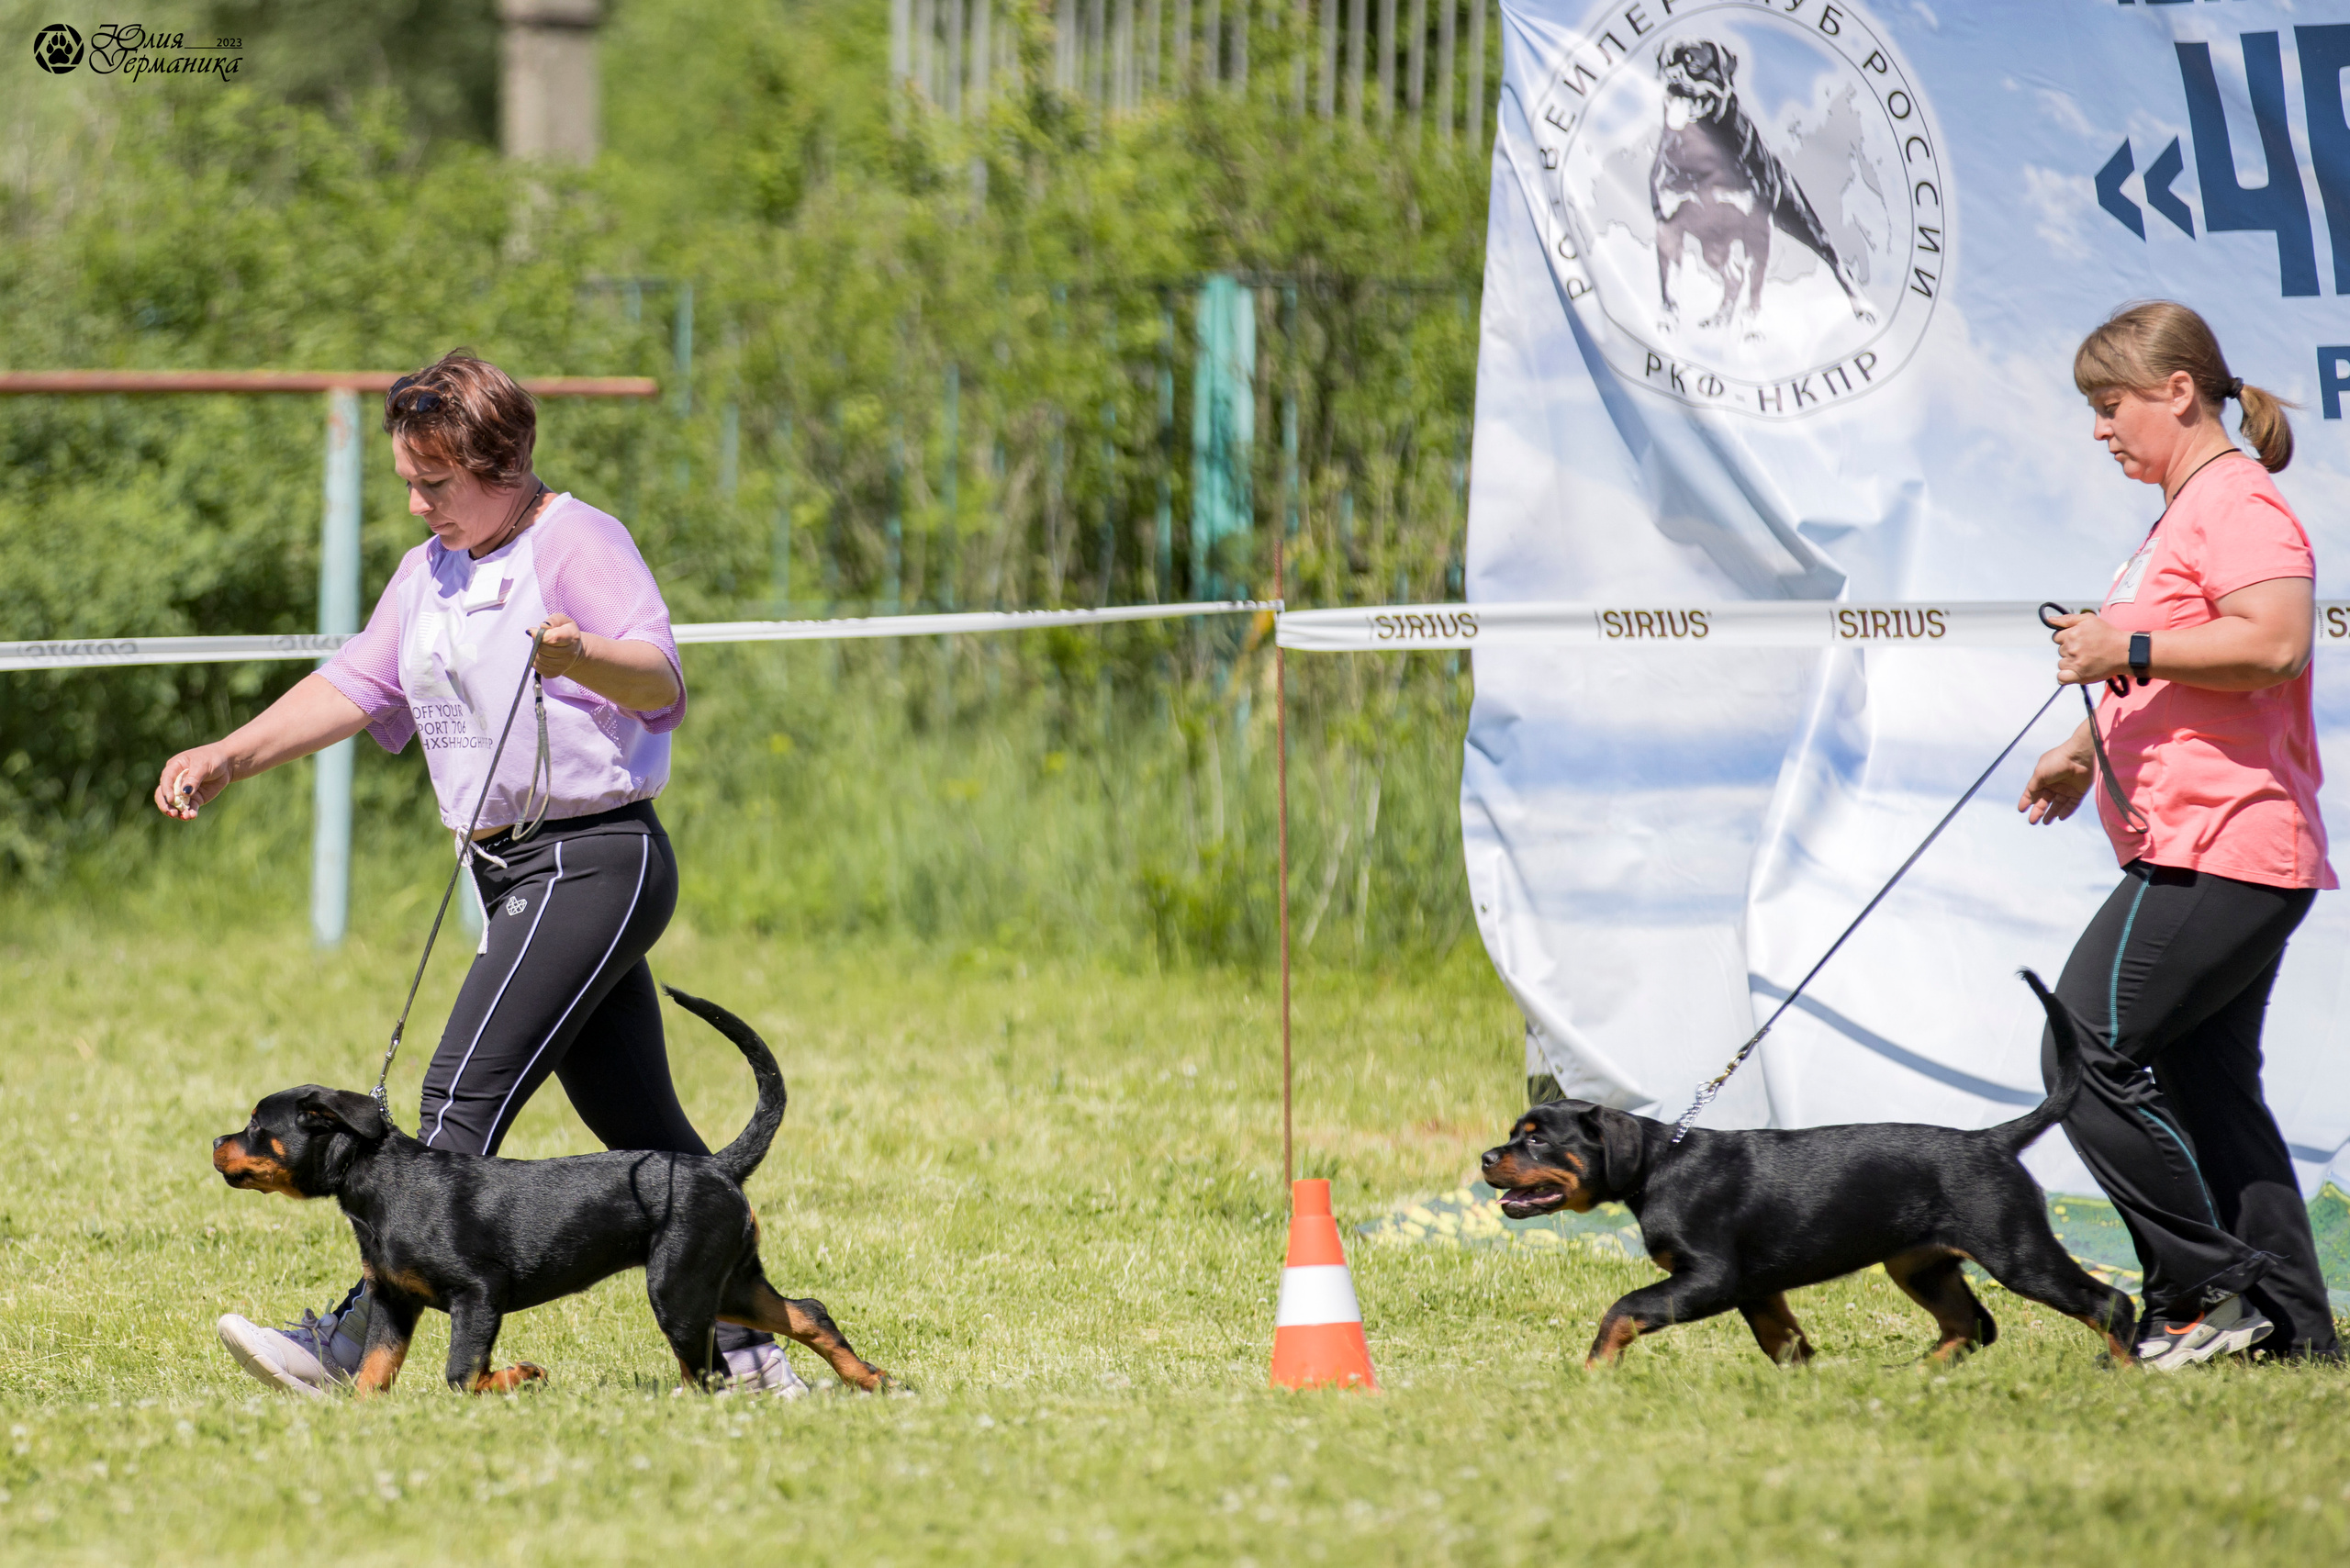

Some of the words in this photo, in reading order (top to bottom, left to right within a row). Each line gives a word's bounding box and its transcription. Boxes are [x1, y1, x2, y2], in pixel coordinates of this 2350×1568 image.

[1863, 50, 1941, 298] РОССИИ
[1646, 352, 1724, 398] РКФ
[1757, 352, 1877, 412] НКПР
[1375, 612, 1479, 639] SIRIUS
[1603, 610, 1709, 638] SIRIUS
[1839, 610, 1946, 638] SIRIUS
[412, 705, 433, 719] OFF
[435, 704, 464, 717] YOUR
